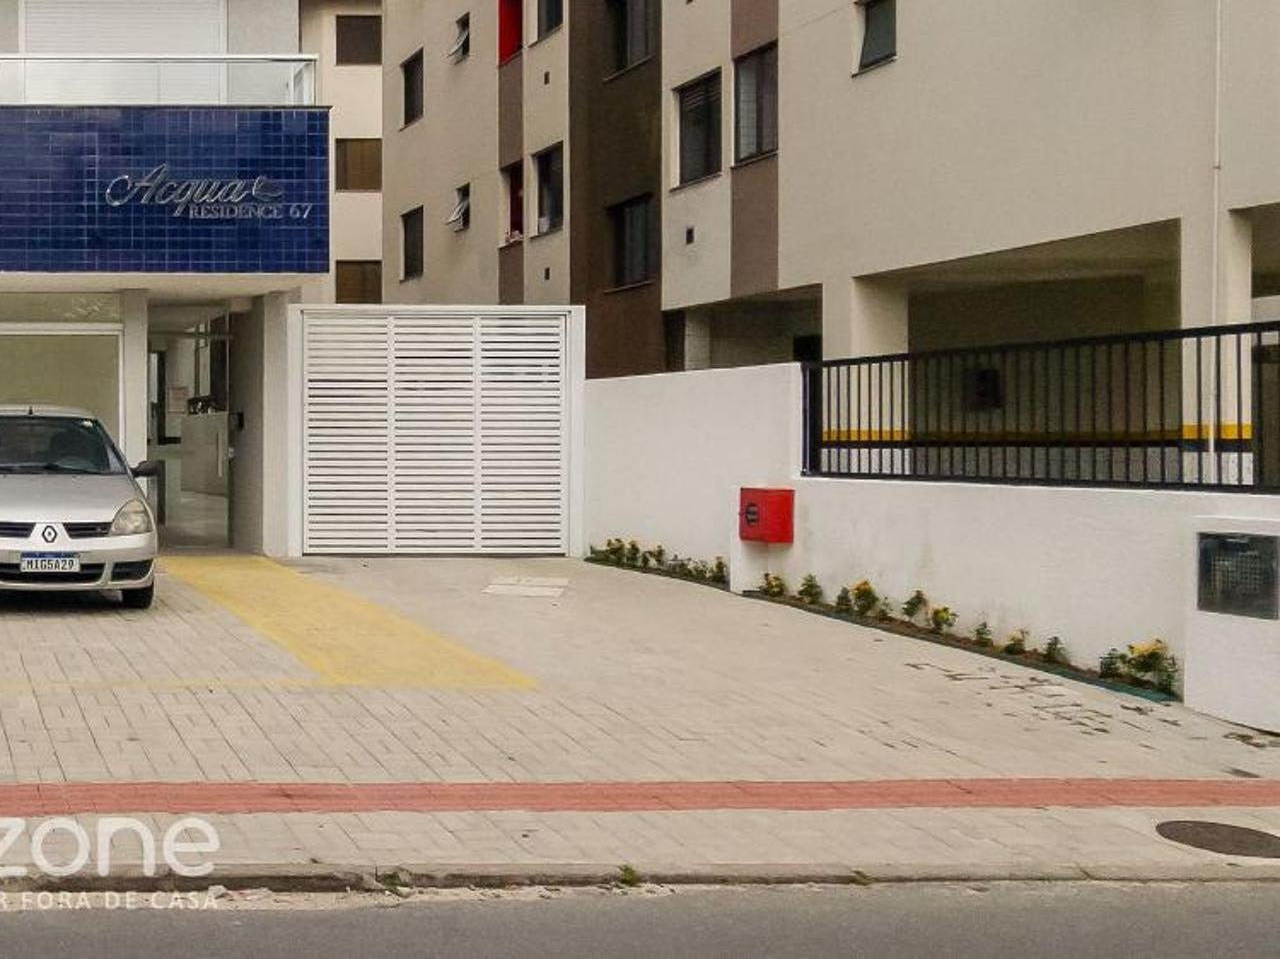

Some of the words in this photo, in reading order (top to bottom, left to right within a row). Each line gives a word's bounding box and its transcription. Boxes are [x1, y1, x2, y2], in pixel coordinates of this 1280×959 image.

[106, 162, 249, 217] Acqua
[189, 203, 282, 219] RESIDENCE
[289, 203, 312, 219] 67
